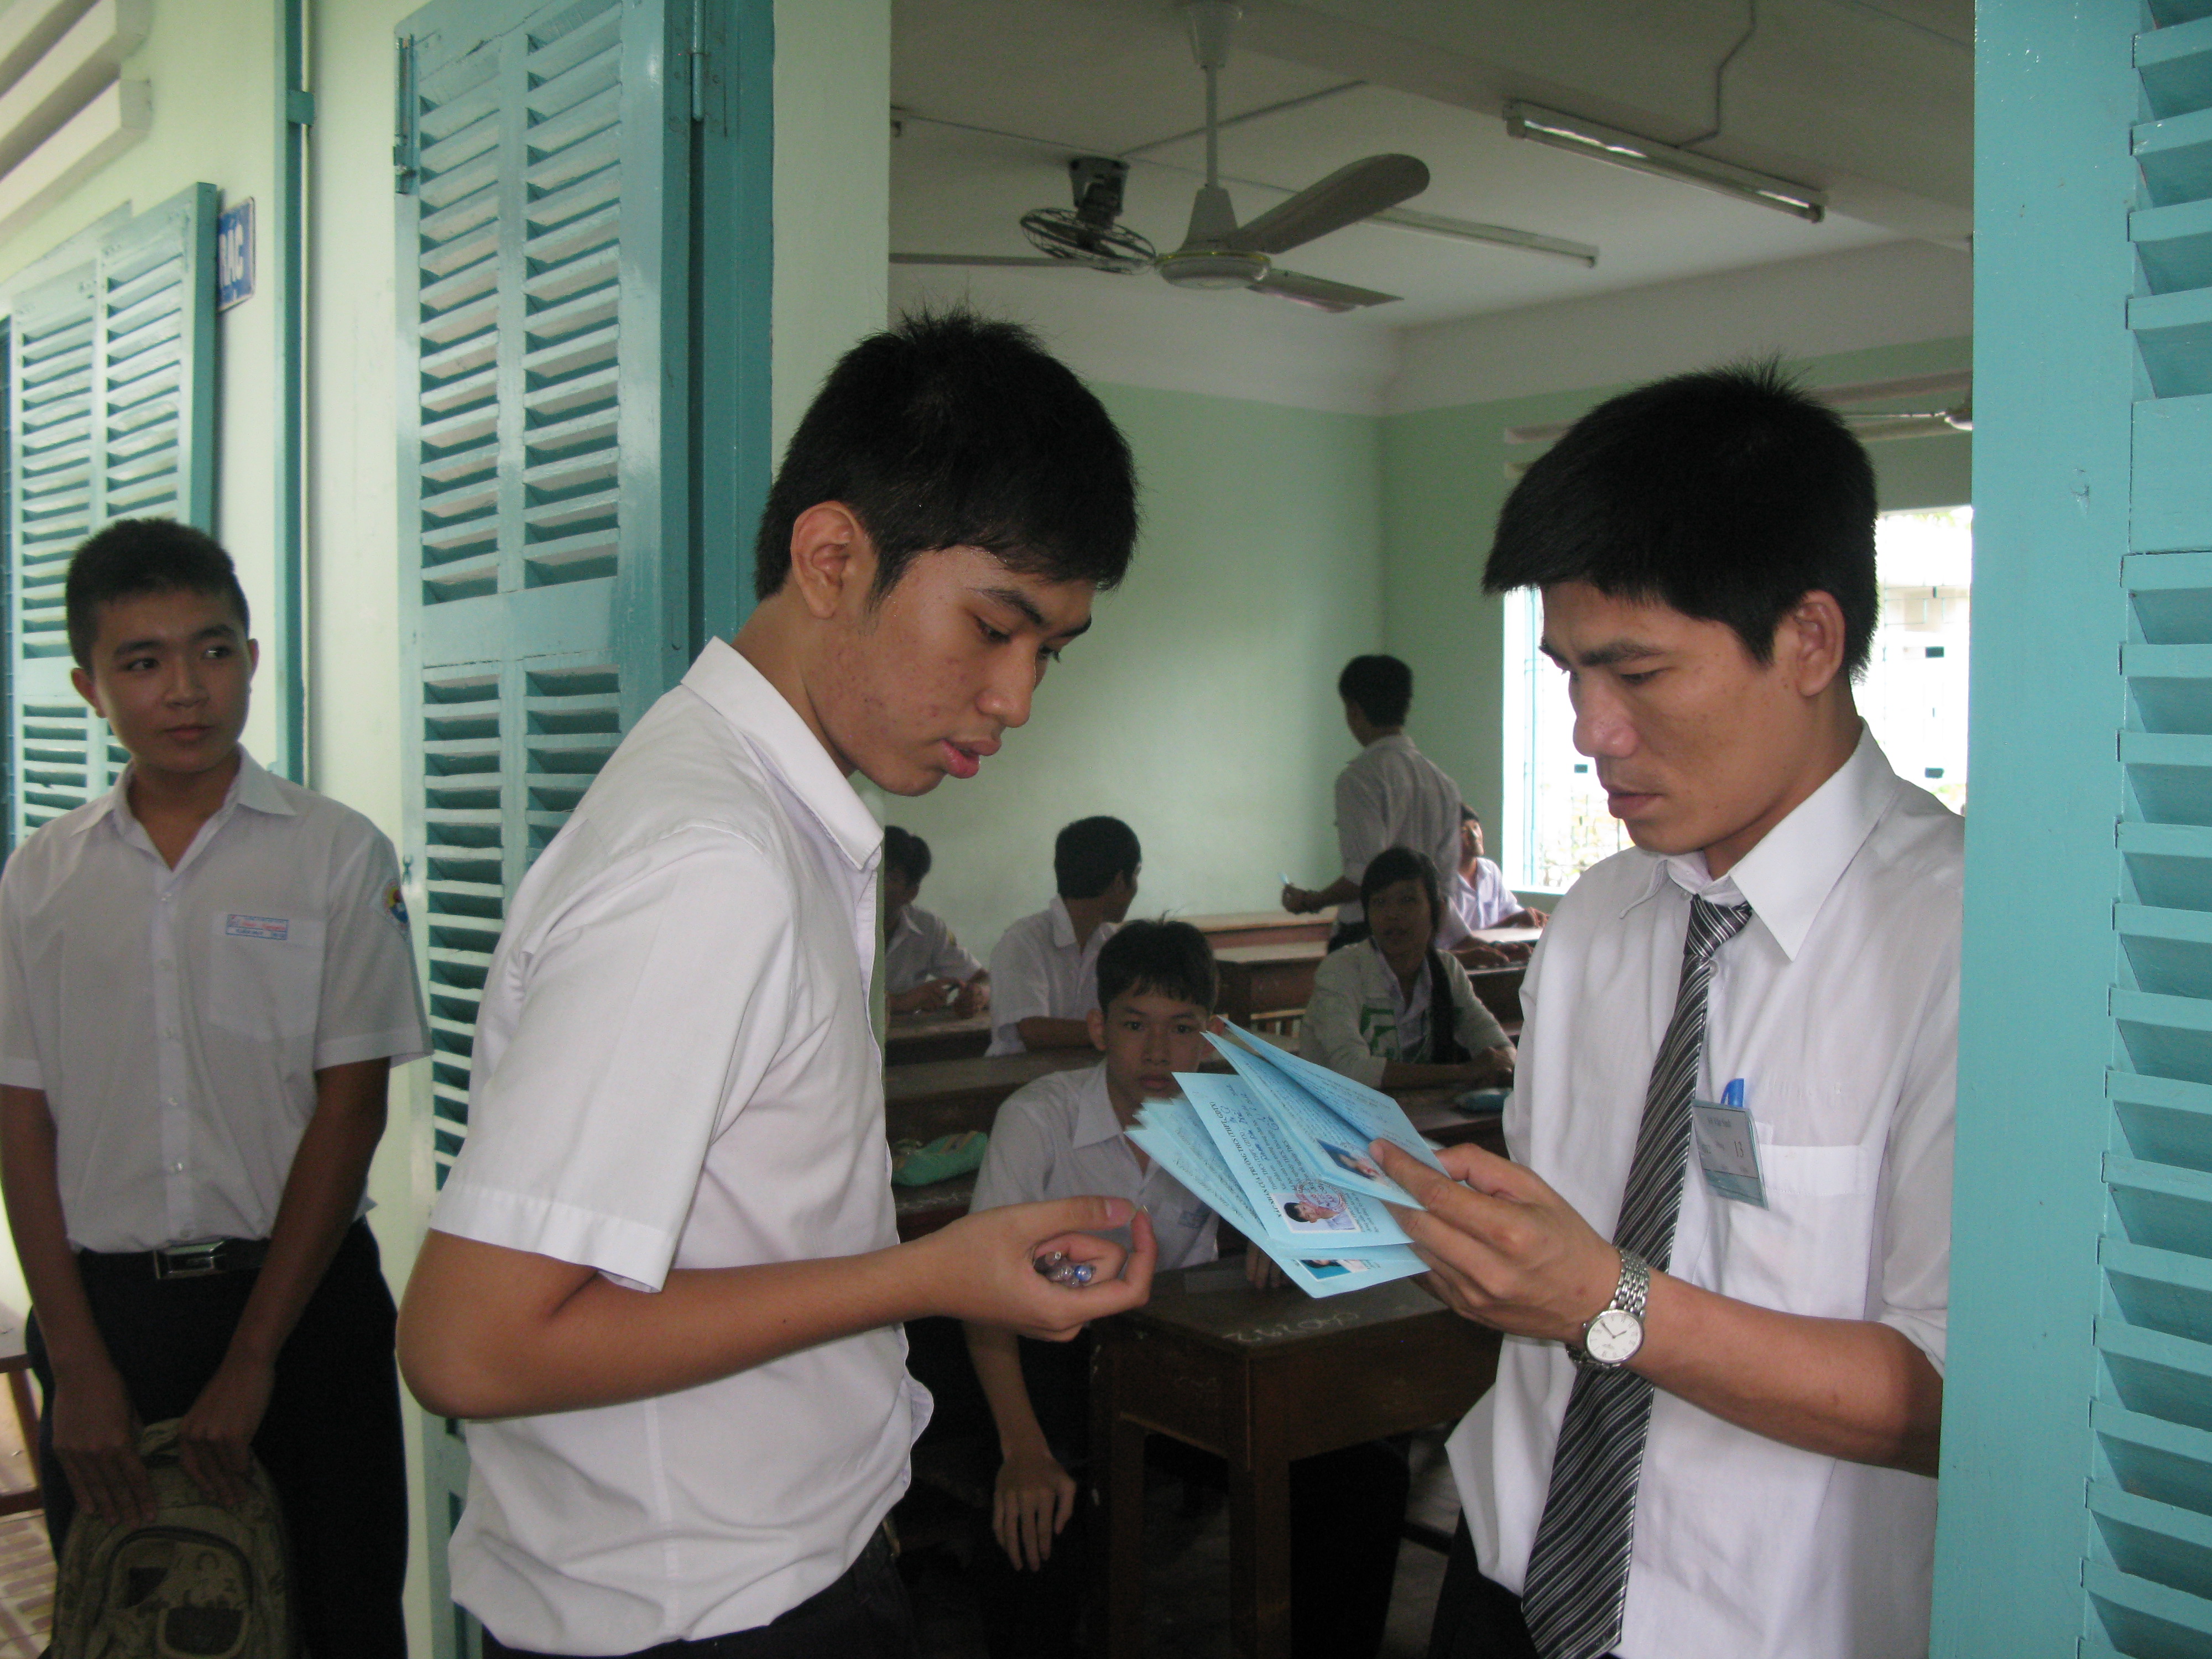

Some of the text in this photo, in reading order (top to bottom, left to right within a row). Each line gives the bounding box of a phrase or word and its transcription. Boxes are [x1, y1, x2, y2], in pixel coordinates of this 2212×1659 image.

[1208, 1101, 1224, 1118] GDTX)
[1230, 1138, 1244, 1152] THCS
[1238, 1153, 1259, 1176] TRƯỜNG
[1254, 1177, 1266, 1187] CỦA
